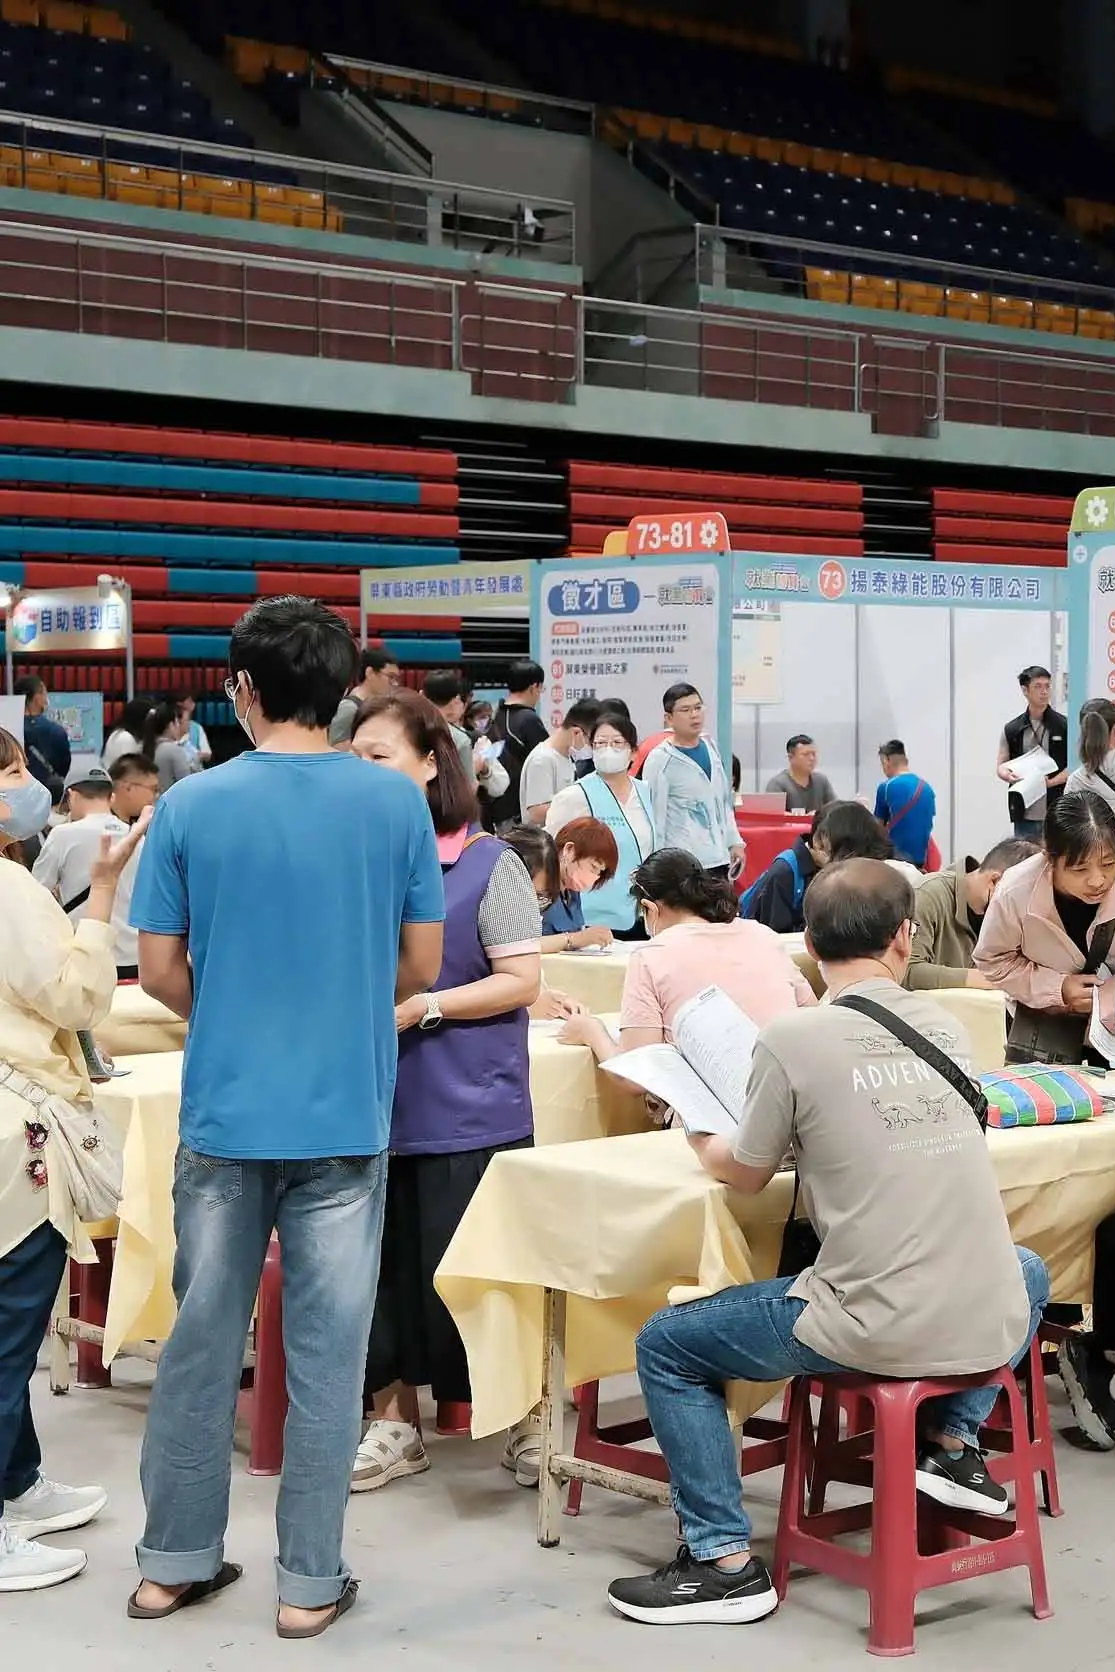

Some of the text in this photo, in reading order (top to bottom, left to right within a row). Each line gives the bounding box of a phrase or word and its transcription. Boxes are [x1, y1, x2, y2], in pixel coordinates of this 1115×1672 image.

[636, 521, 693, 549] 73-81
[562, 580, 626, 612] 徵才區
[821, 569, 1041, 600] 73 揚泰綠能股份有限公司
[41, 604, 121, 632] 自助報到區
